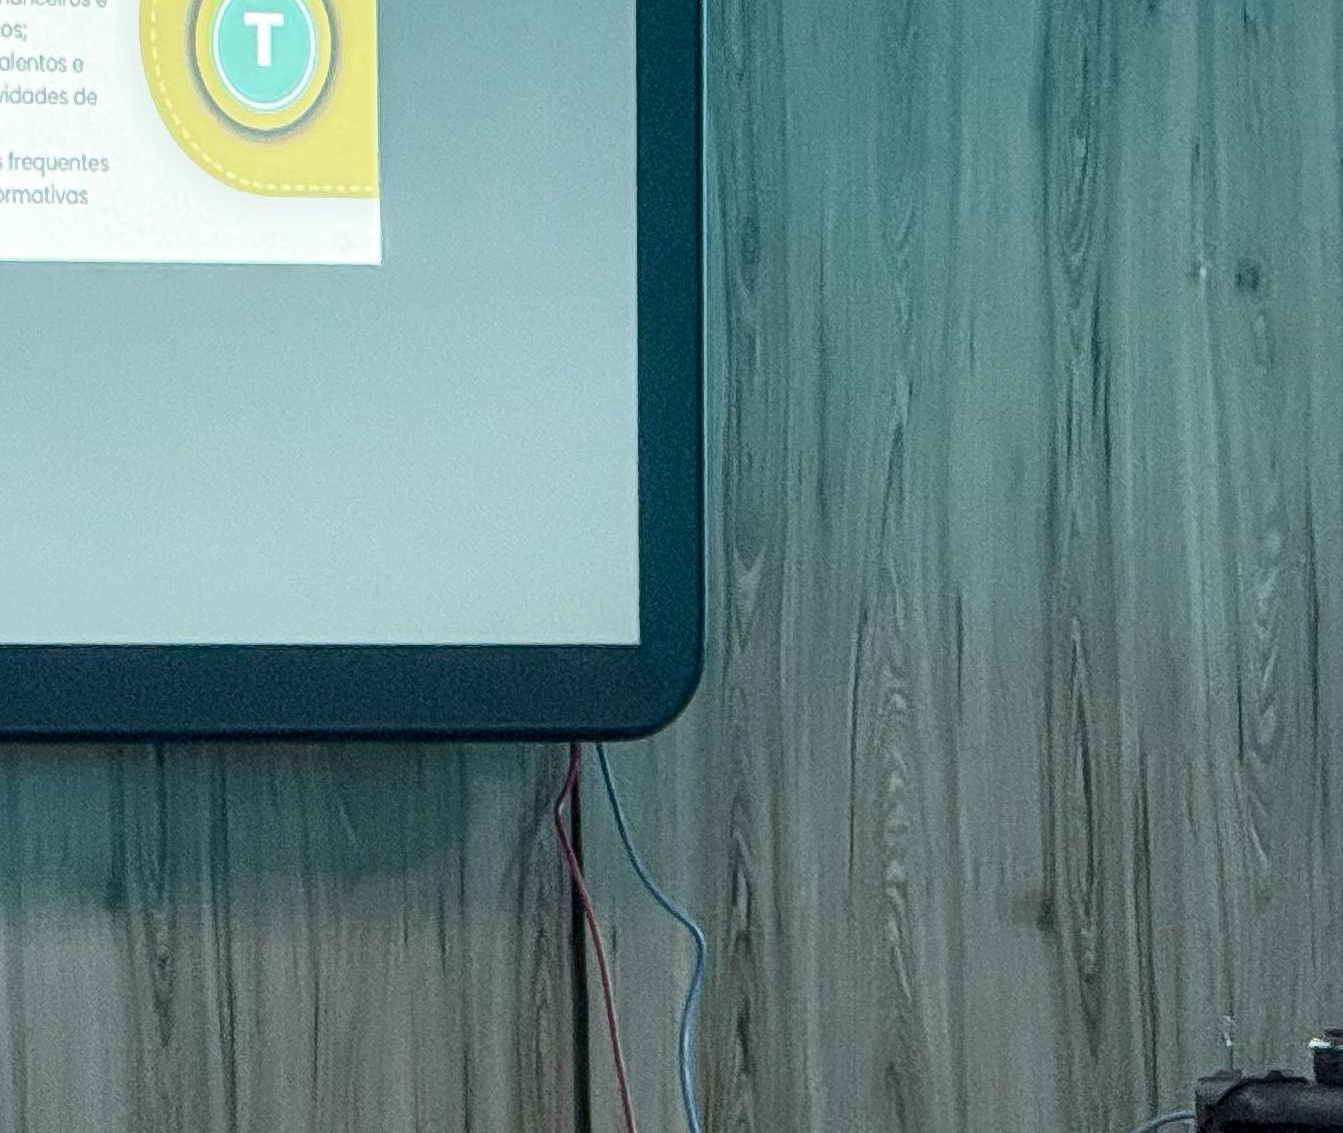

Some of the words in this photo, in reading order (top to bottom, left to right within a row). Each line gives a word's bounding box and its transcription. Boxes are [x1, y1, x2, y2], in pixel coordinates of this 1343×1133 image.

[244, 12, 284, 67] T
[72, 58, 84, 74] e
[73, 88, 98, 106] de
[8, 152, 110, 178] frequentes
